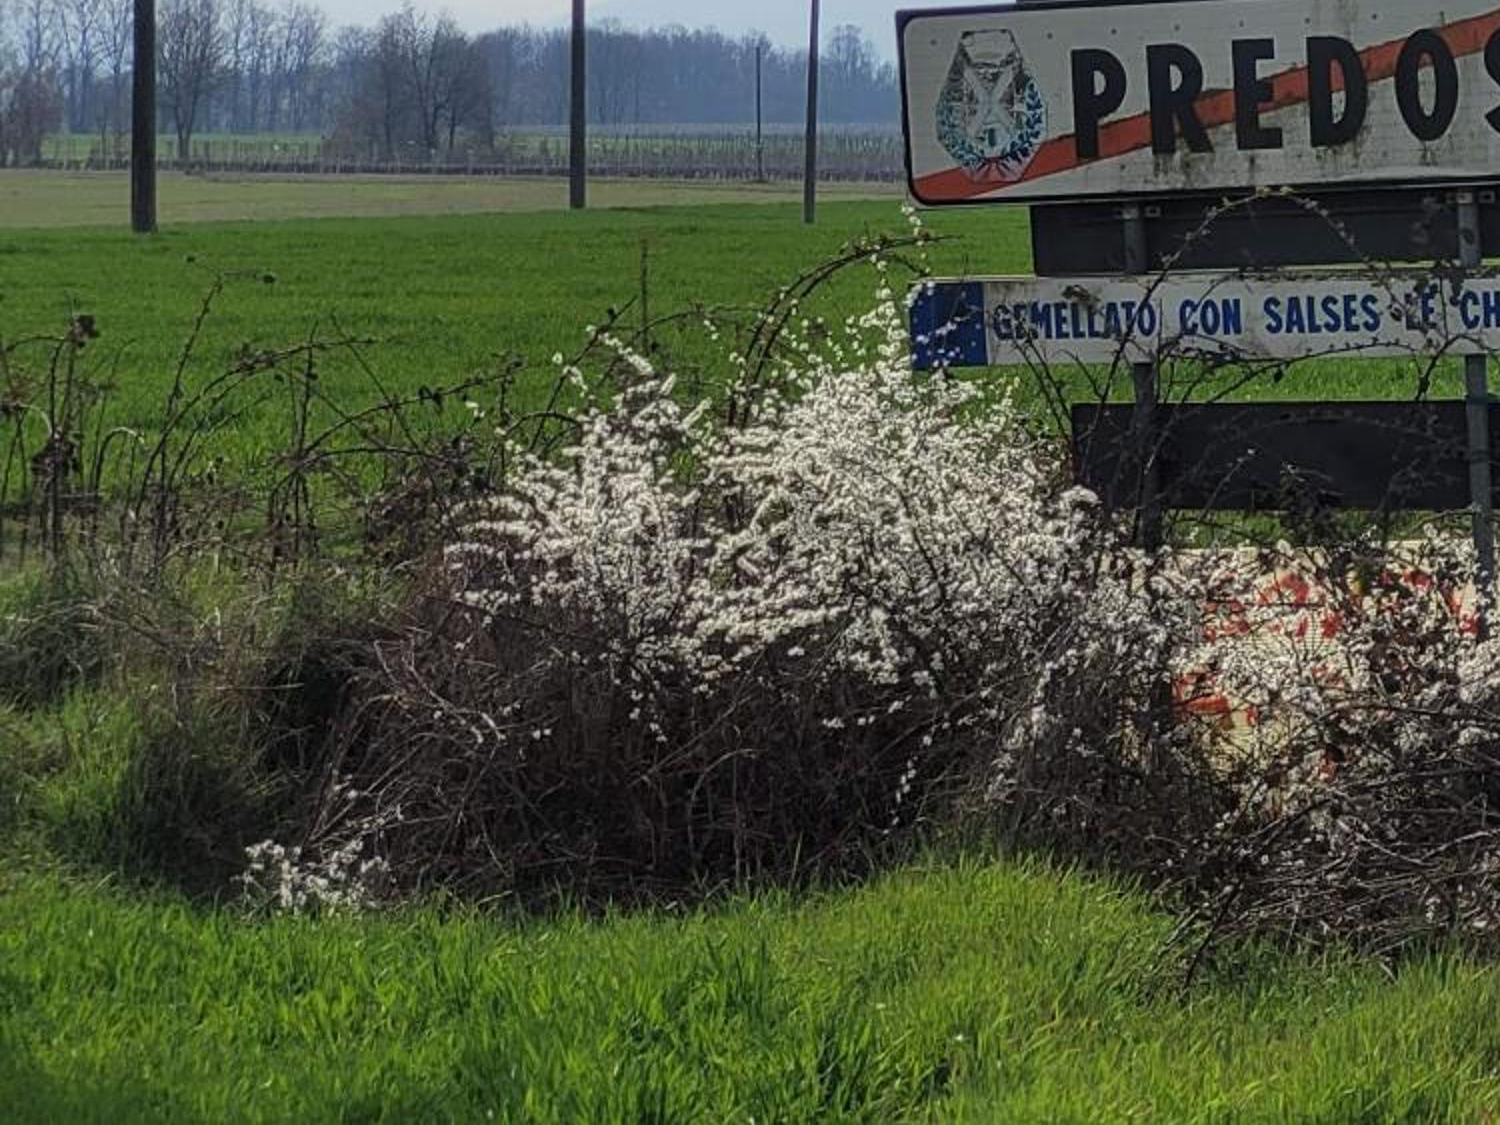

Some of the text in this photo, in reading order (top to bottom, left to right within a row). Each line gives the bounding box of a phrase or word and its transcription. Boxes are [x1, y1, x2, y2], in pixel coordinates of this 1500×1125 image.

[991, 298, 1157, 340] GEMELLATO
[1180, 298, 1242, 336] CON
[1264, 294, 1381, 335] SALSES
